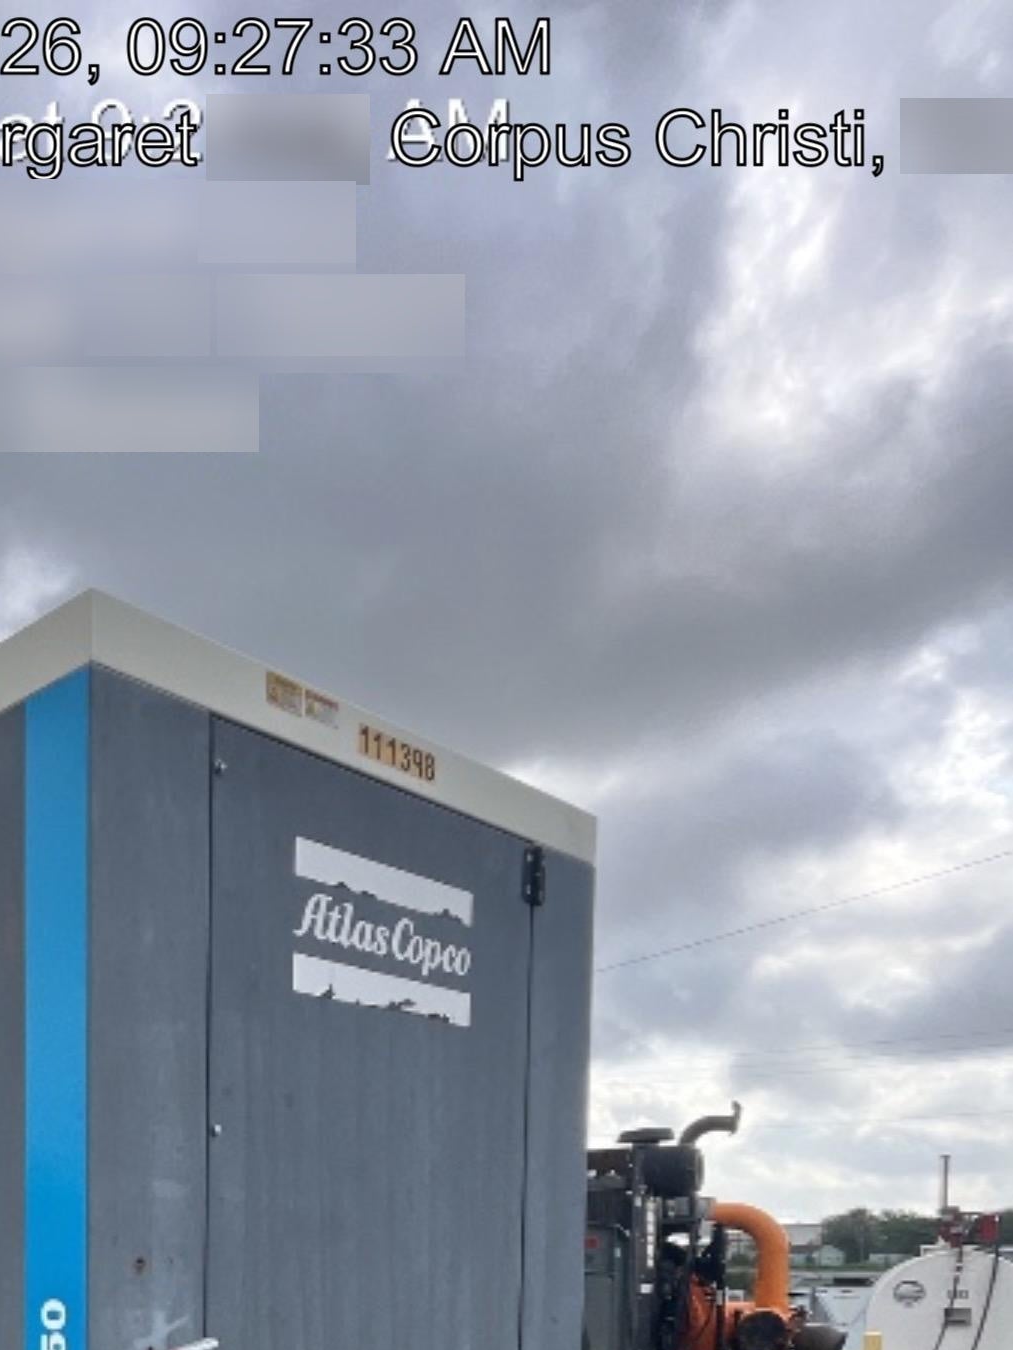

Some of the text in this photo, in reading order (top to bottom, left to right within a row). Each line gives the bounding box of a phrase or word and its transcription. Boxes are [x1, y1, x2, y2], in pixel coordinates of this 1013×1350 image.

[358, 725, 436, 782] 111398
[293, 893, 471, 977] Atlas Copco
